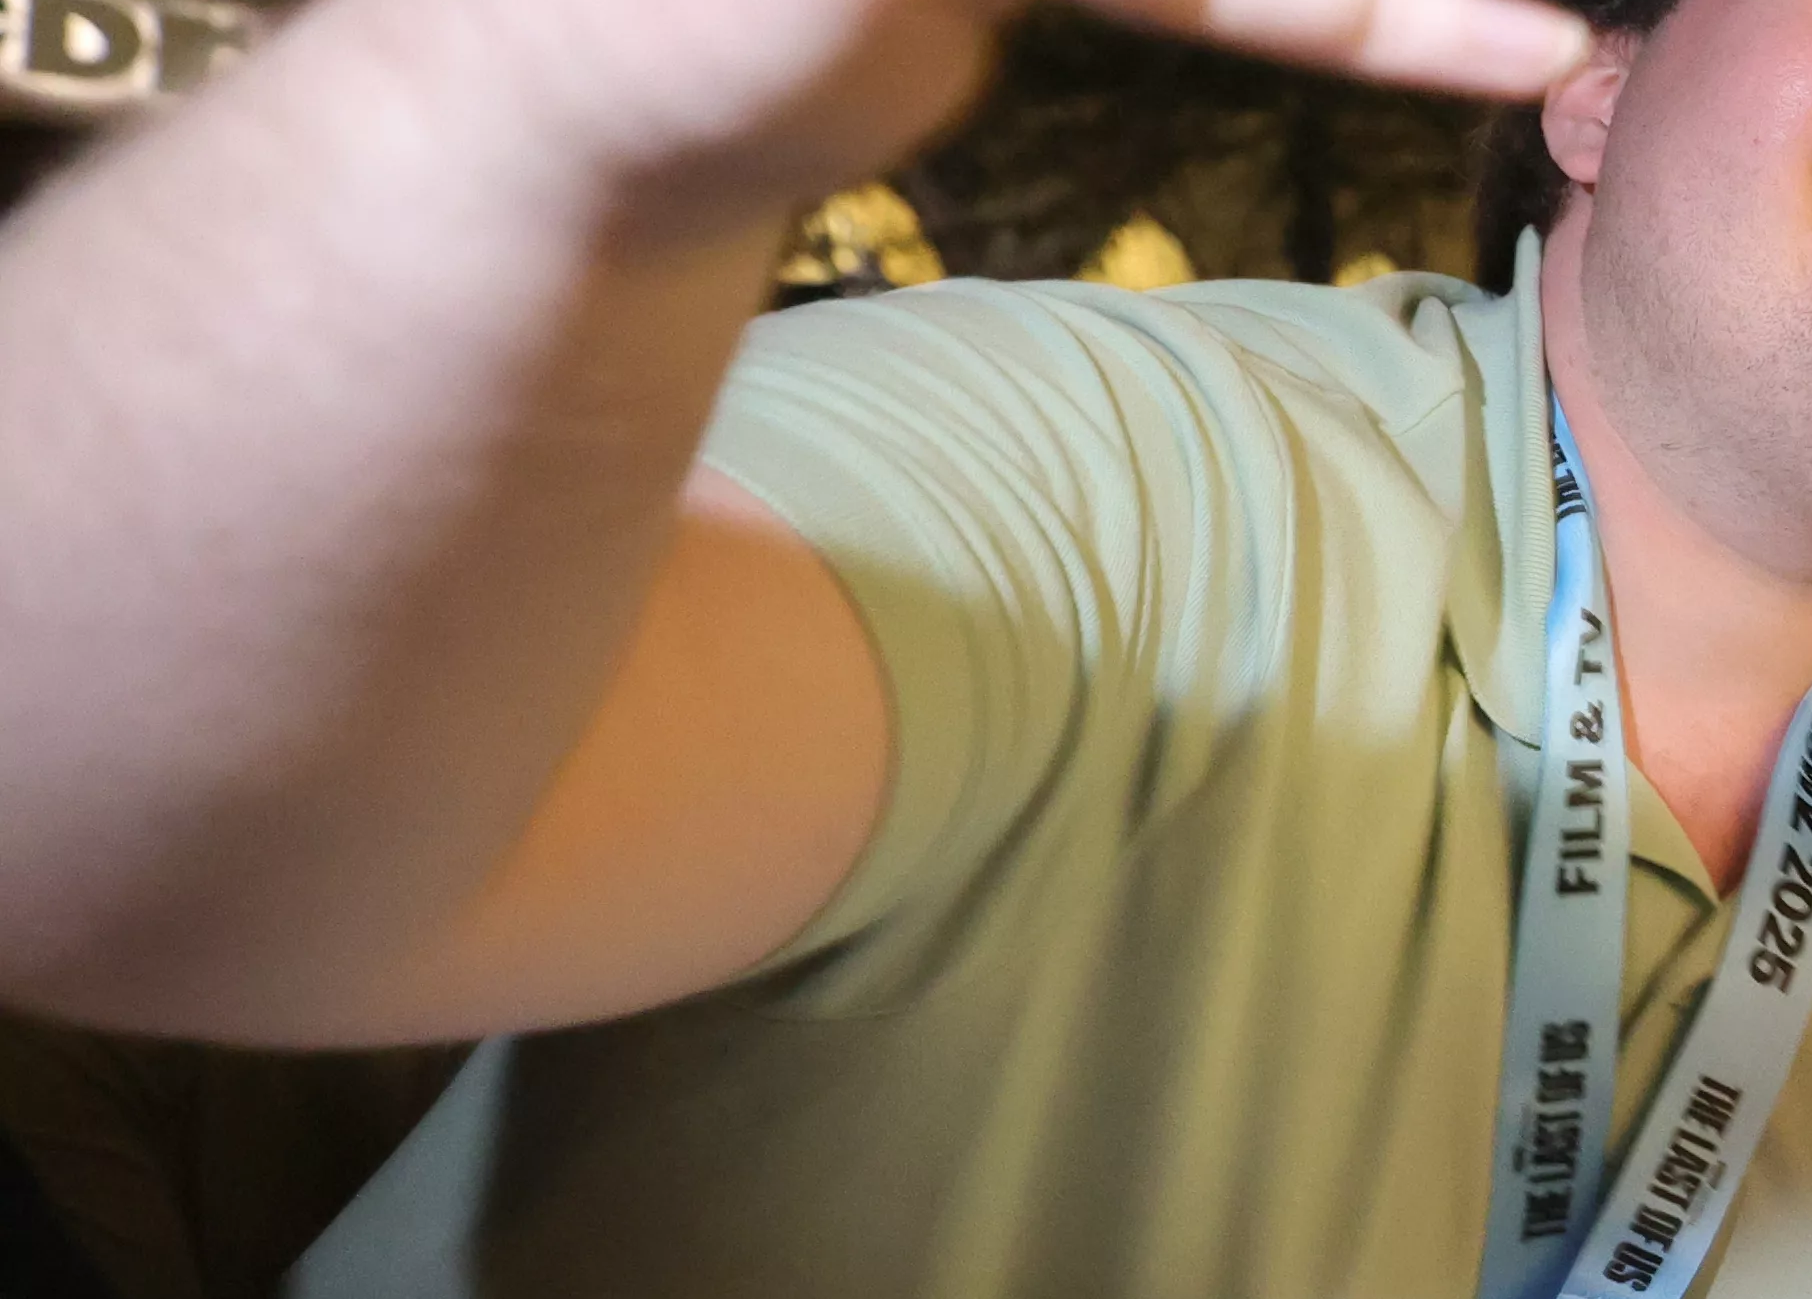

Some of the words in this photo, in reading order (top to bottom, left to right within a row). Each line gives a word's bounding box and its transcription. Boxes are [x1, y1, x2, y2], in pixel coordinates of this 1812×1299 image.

[1574, 607, 1604, 686] TV
[1570, 700, 1604, 744] &
[1556, 761, 1604, 895] FILM
[1681, 1075, 1744, 1136] THE
[1648, 1126, 1718, 1212] LAST
[1628, 1204, 1684, 1253] OF
[1602, 1241, 1665, 1292] US
